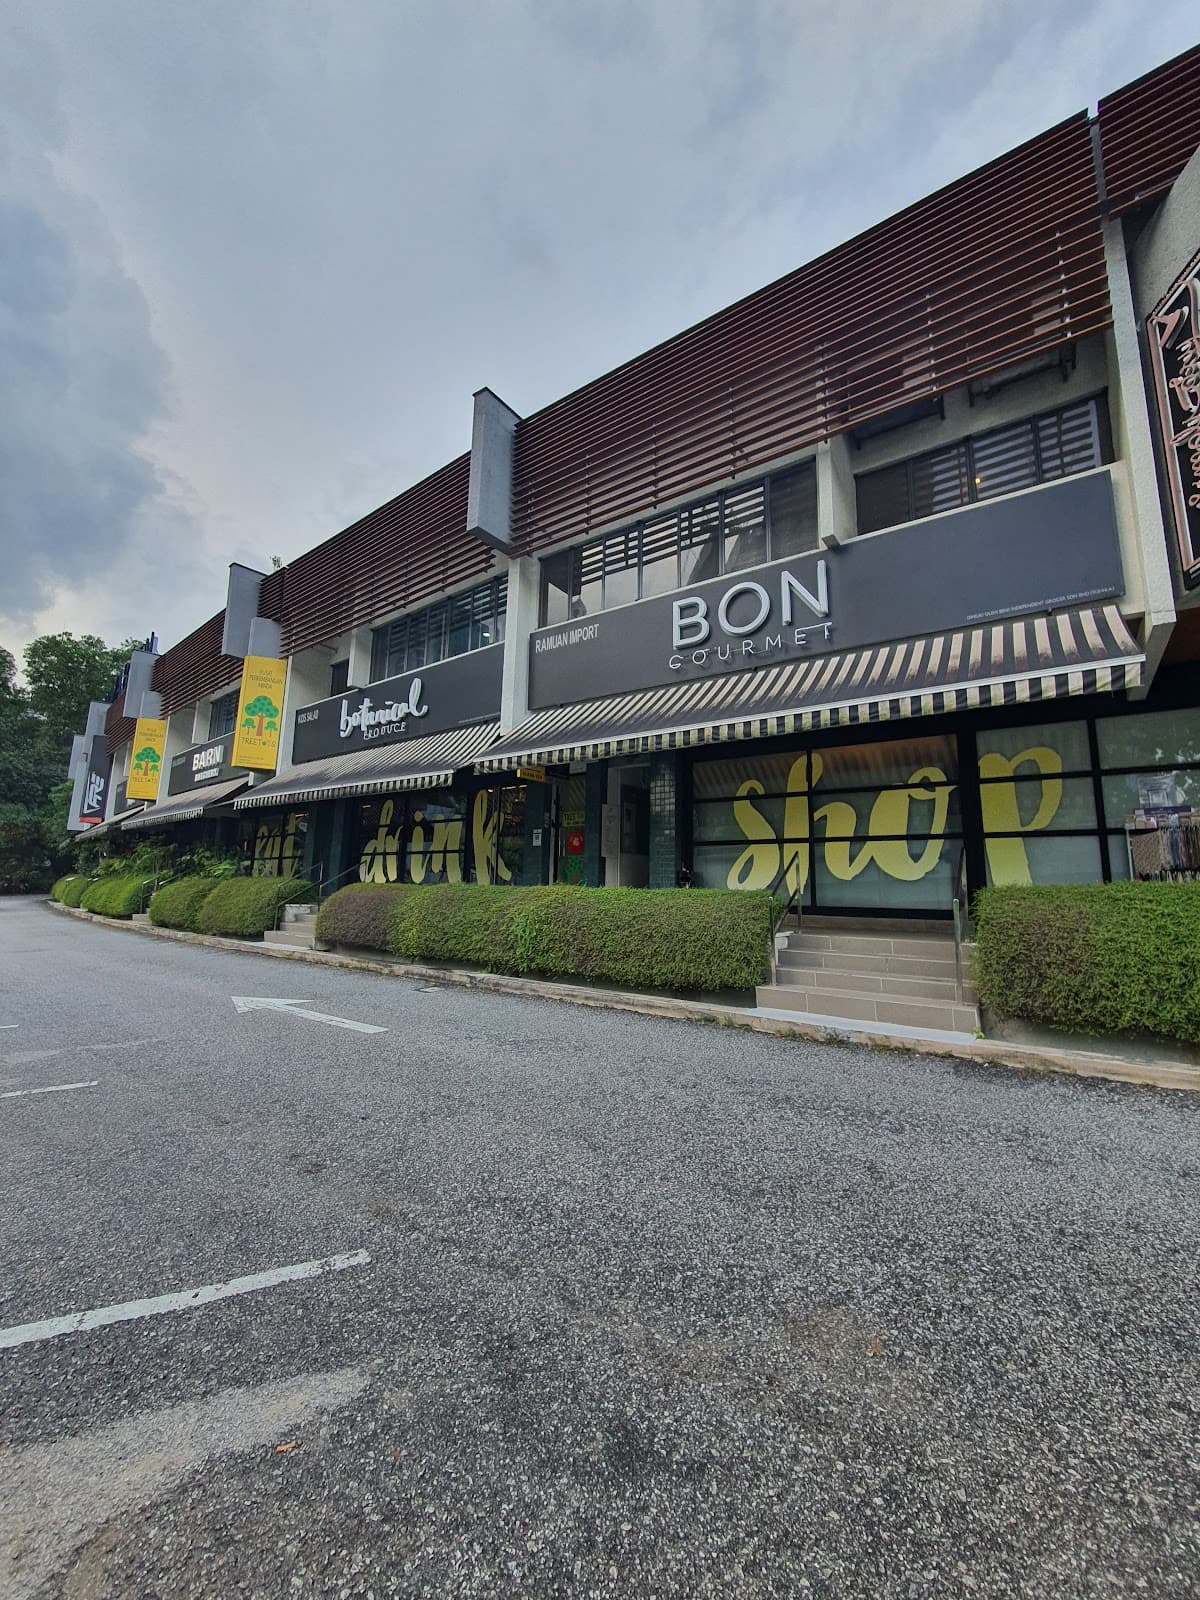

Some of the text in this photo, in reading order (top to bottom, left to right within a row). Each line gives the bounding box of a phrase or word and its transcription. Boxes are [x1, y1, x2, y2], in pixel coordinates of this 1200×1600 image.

[672, 559, 829, 649] BON
[535, 623, 600, 654] RAMUAN IMPORT
[668, 622, 833, 670] GOURMET
[339, 677, 429, 738] botanical
[363, 721, 407, 741] PRODUCE
[192, 744, 225, 772] BARN
[359, 788, 513, 885] drink
[727, 746, 1063, 896] shop
